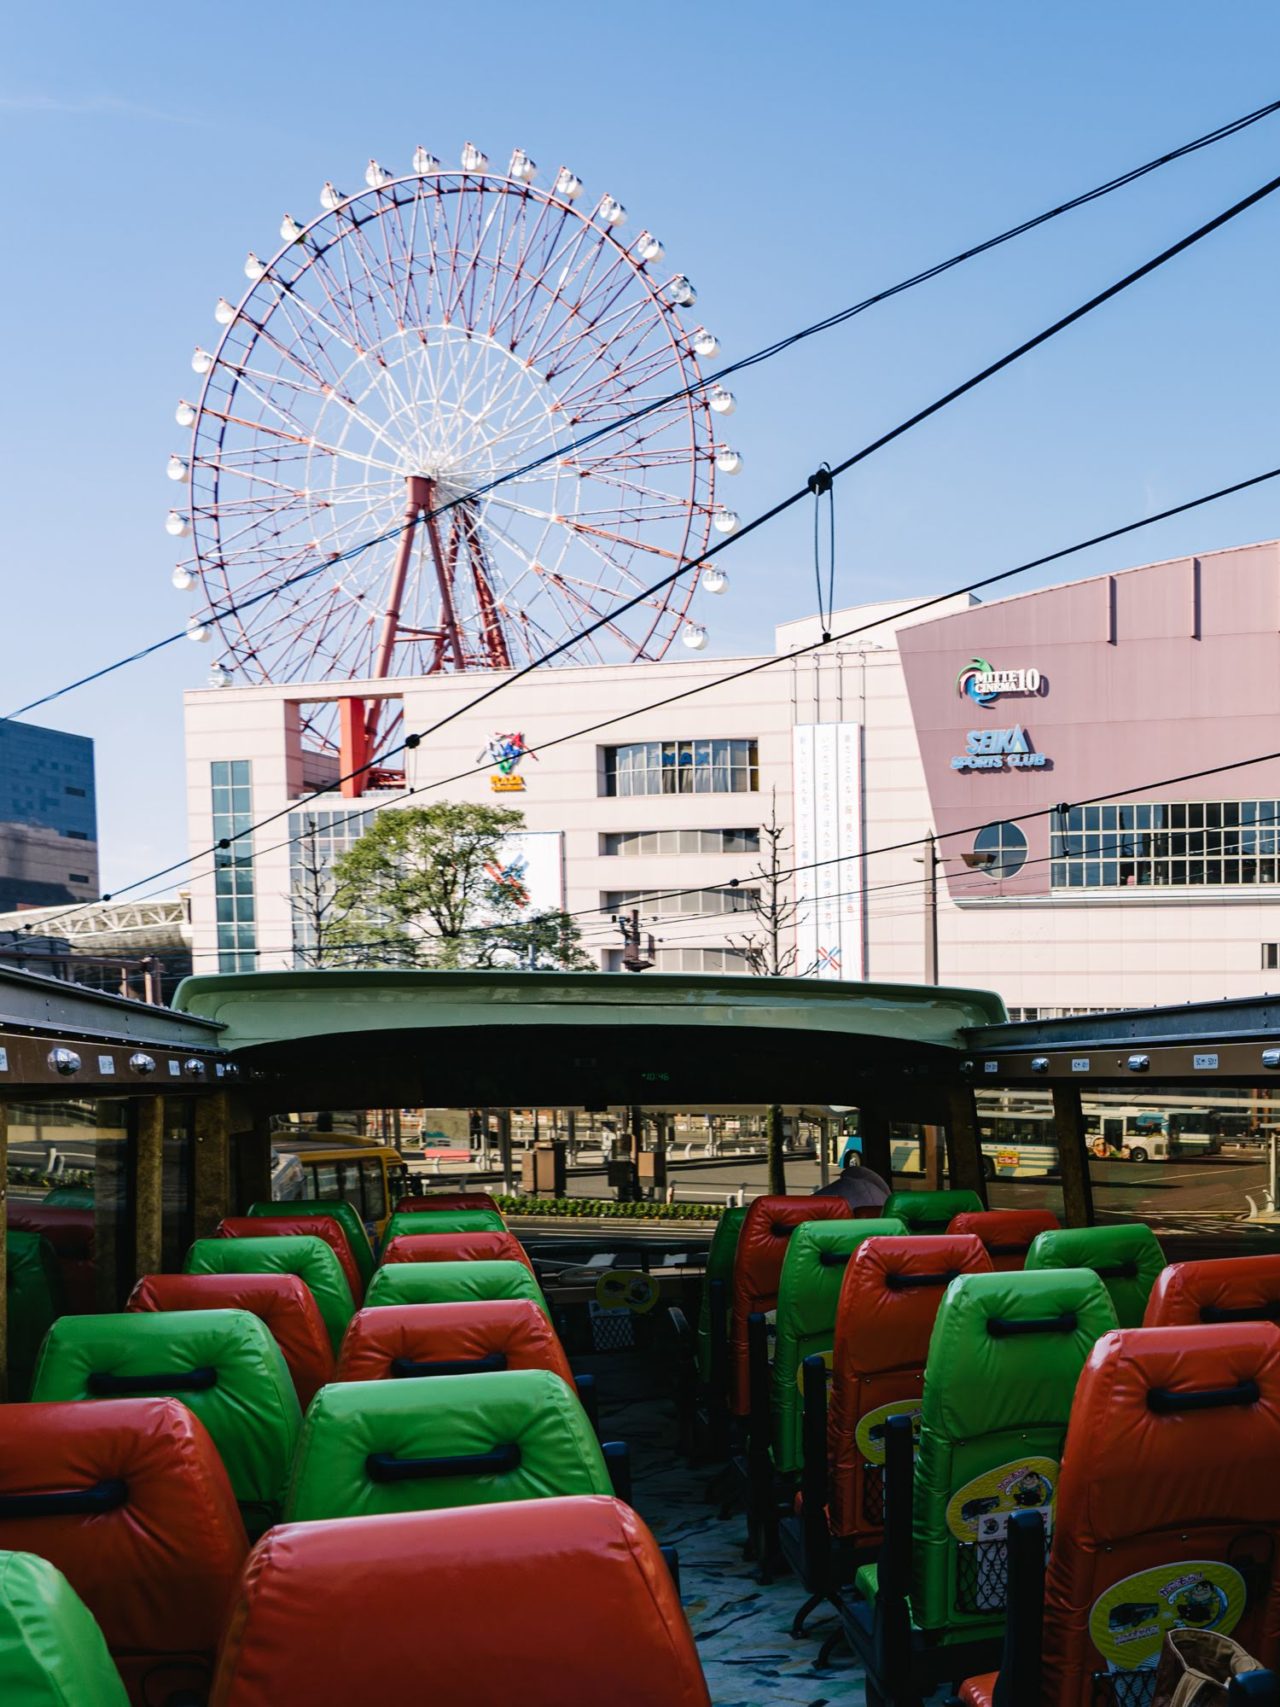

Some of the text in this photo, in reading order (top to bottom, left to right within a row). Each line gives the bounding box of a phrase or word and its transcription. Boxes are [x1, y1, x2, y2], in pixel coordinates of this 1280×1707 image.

[1017, 668, 1040, 692] 10
[967, 724, 1029, 755] SEIKA
[950, 753, 1046, 770] SPORTS CLUB
